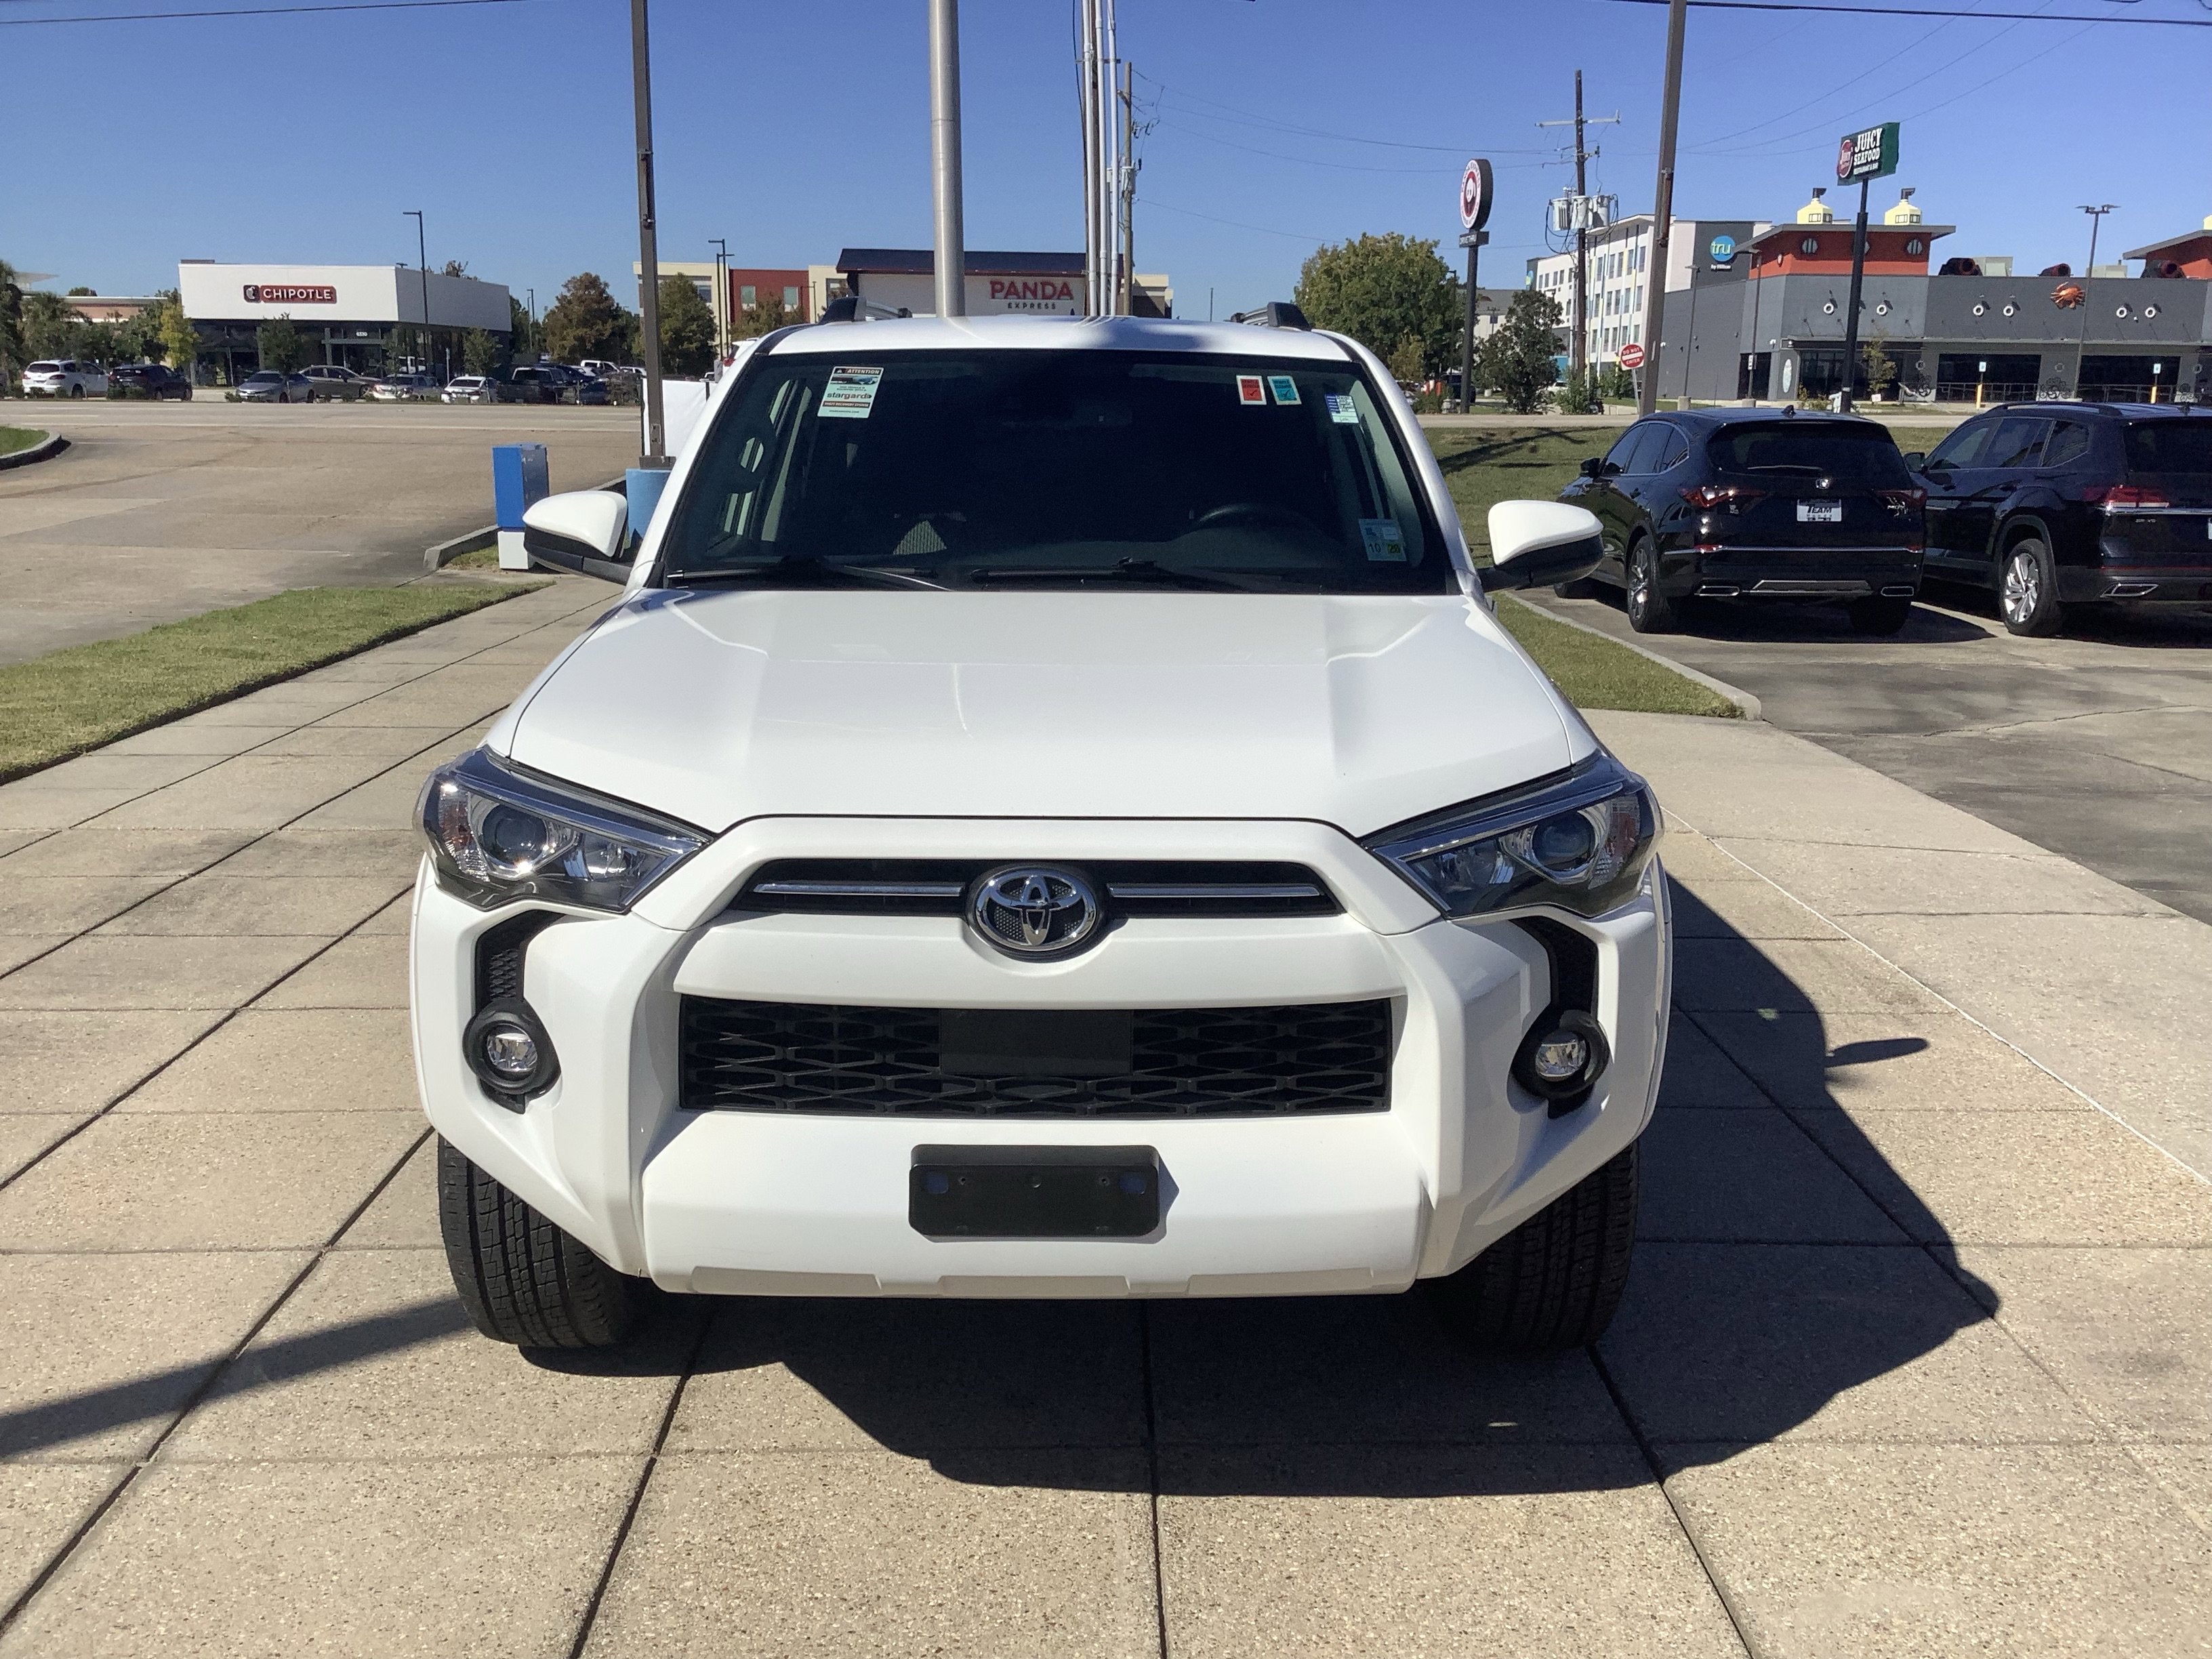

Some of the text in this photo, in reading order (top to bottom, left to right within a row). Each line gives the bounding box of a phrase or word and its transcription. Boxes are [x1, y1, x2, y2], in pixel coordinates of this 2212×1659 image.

[1854, 127, 1883, 153] JUICY
[1853, 147, 1880, 166] SEAFOOD
[1711, 241, 1732, 255] tru
[263, 288, 331, 300] CHIPOTLE
[989, 281, 1074, 300] PANDA
[1369, 543, 1381, 553] 10
